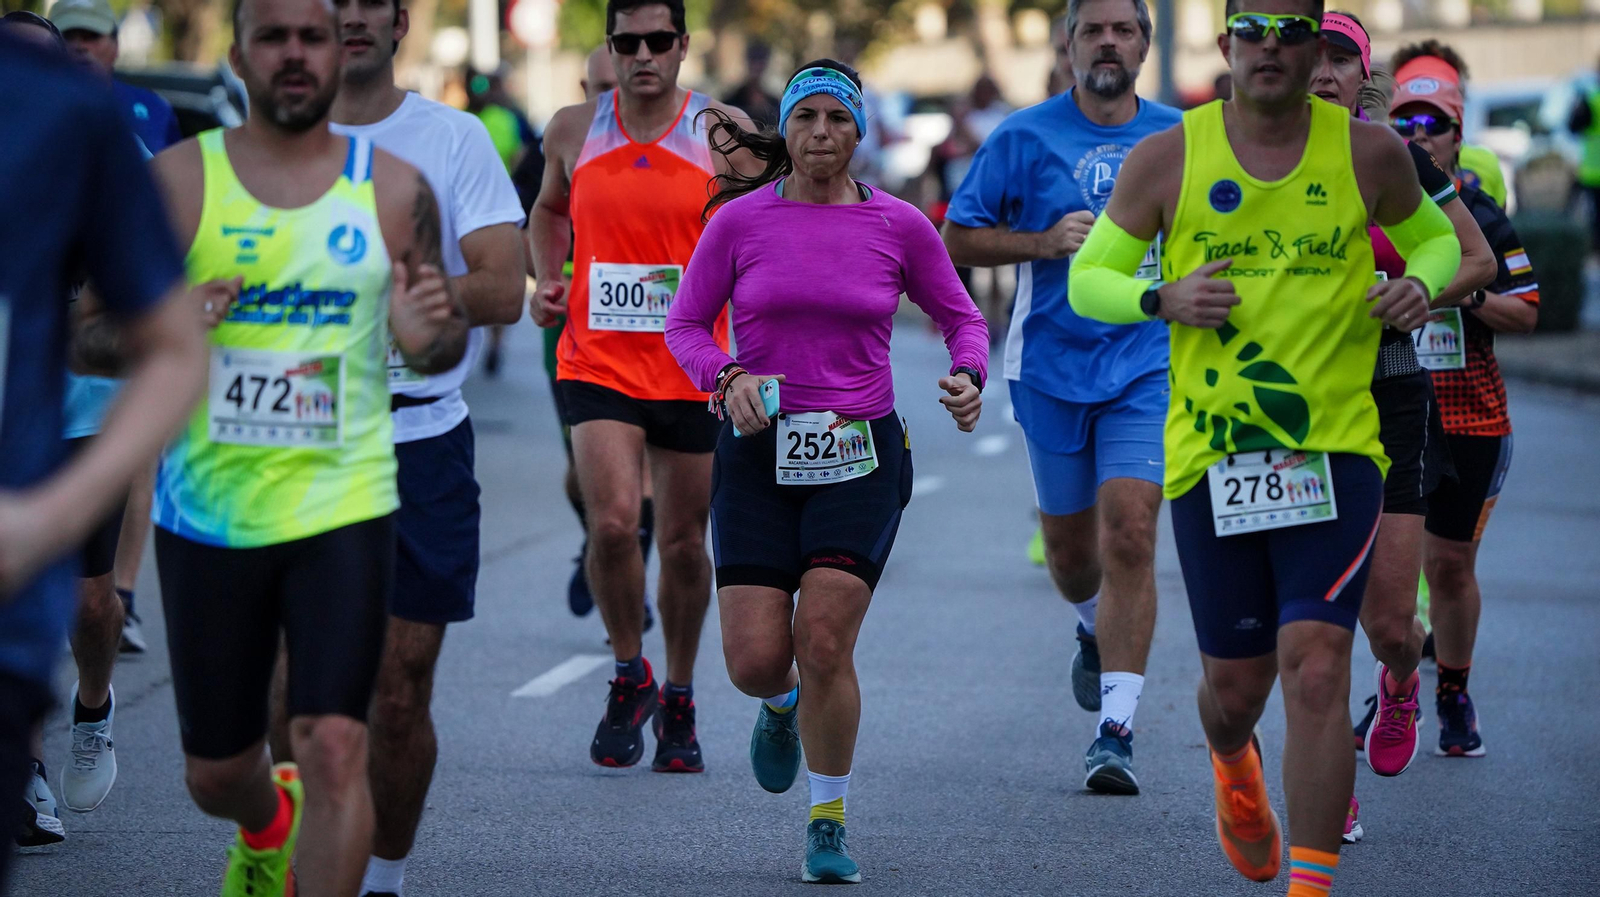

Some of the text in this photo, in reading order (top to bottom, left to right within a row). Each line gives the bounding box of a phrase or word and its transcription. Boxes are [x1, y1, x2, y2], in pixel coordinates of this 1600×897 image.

[1193, 226, 1356, 262] Track & Field
[600, 281, 644, 308] 300
[226, 373, 291, 412] 472
[787, 431, 837, 460] 252
[1225, 472, 1283, 506] 278
